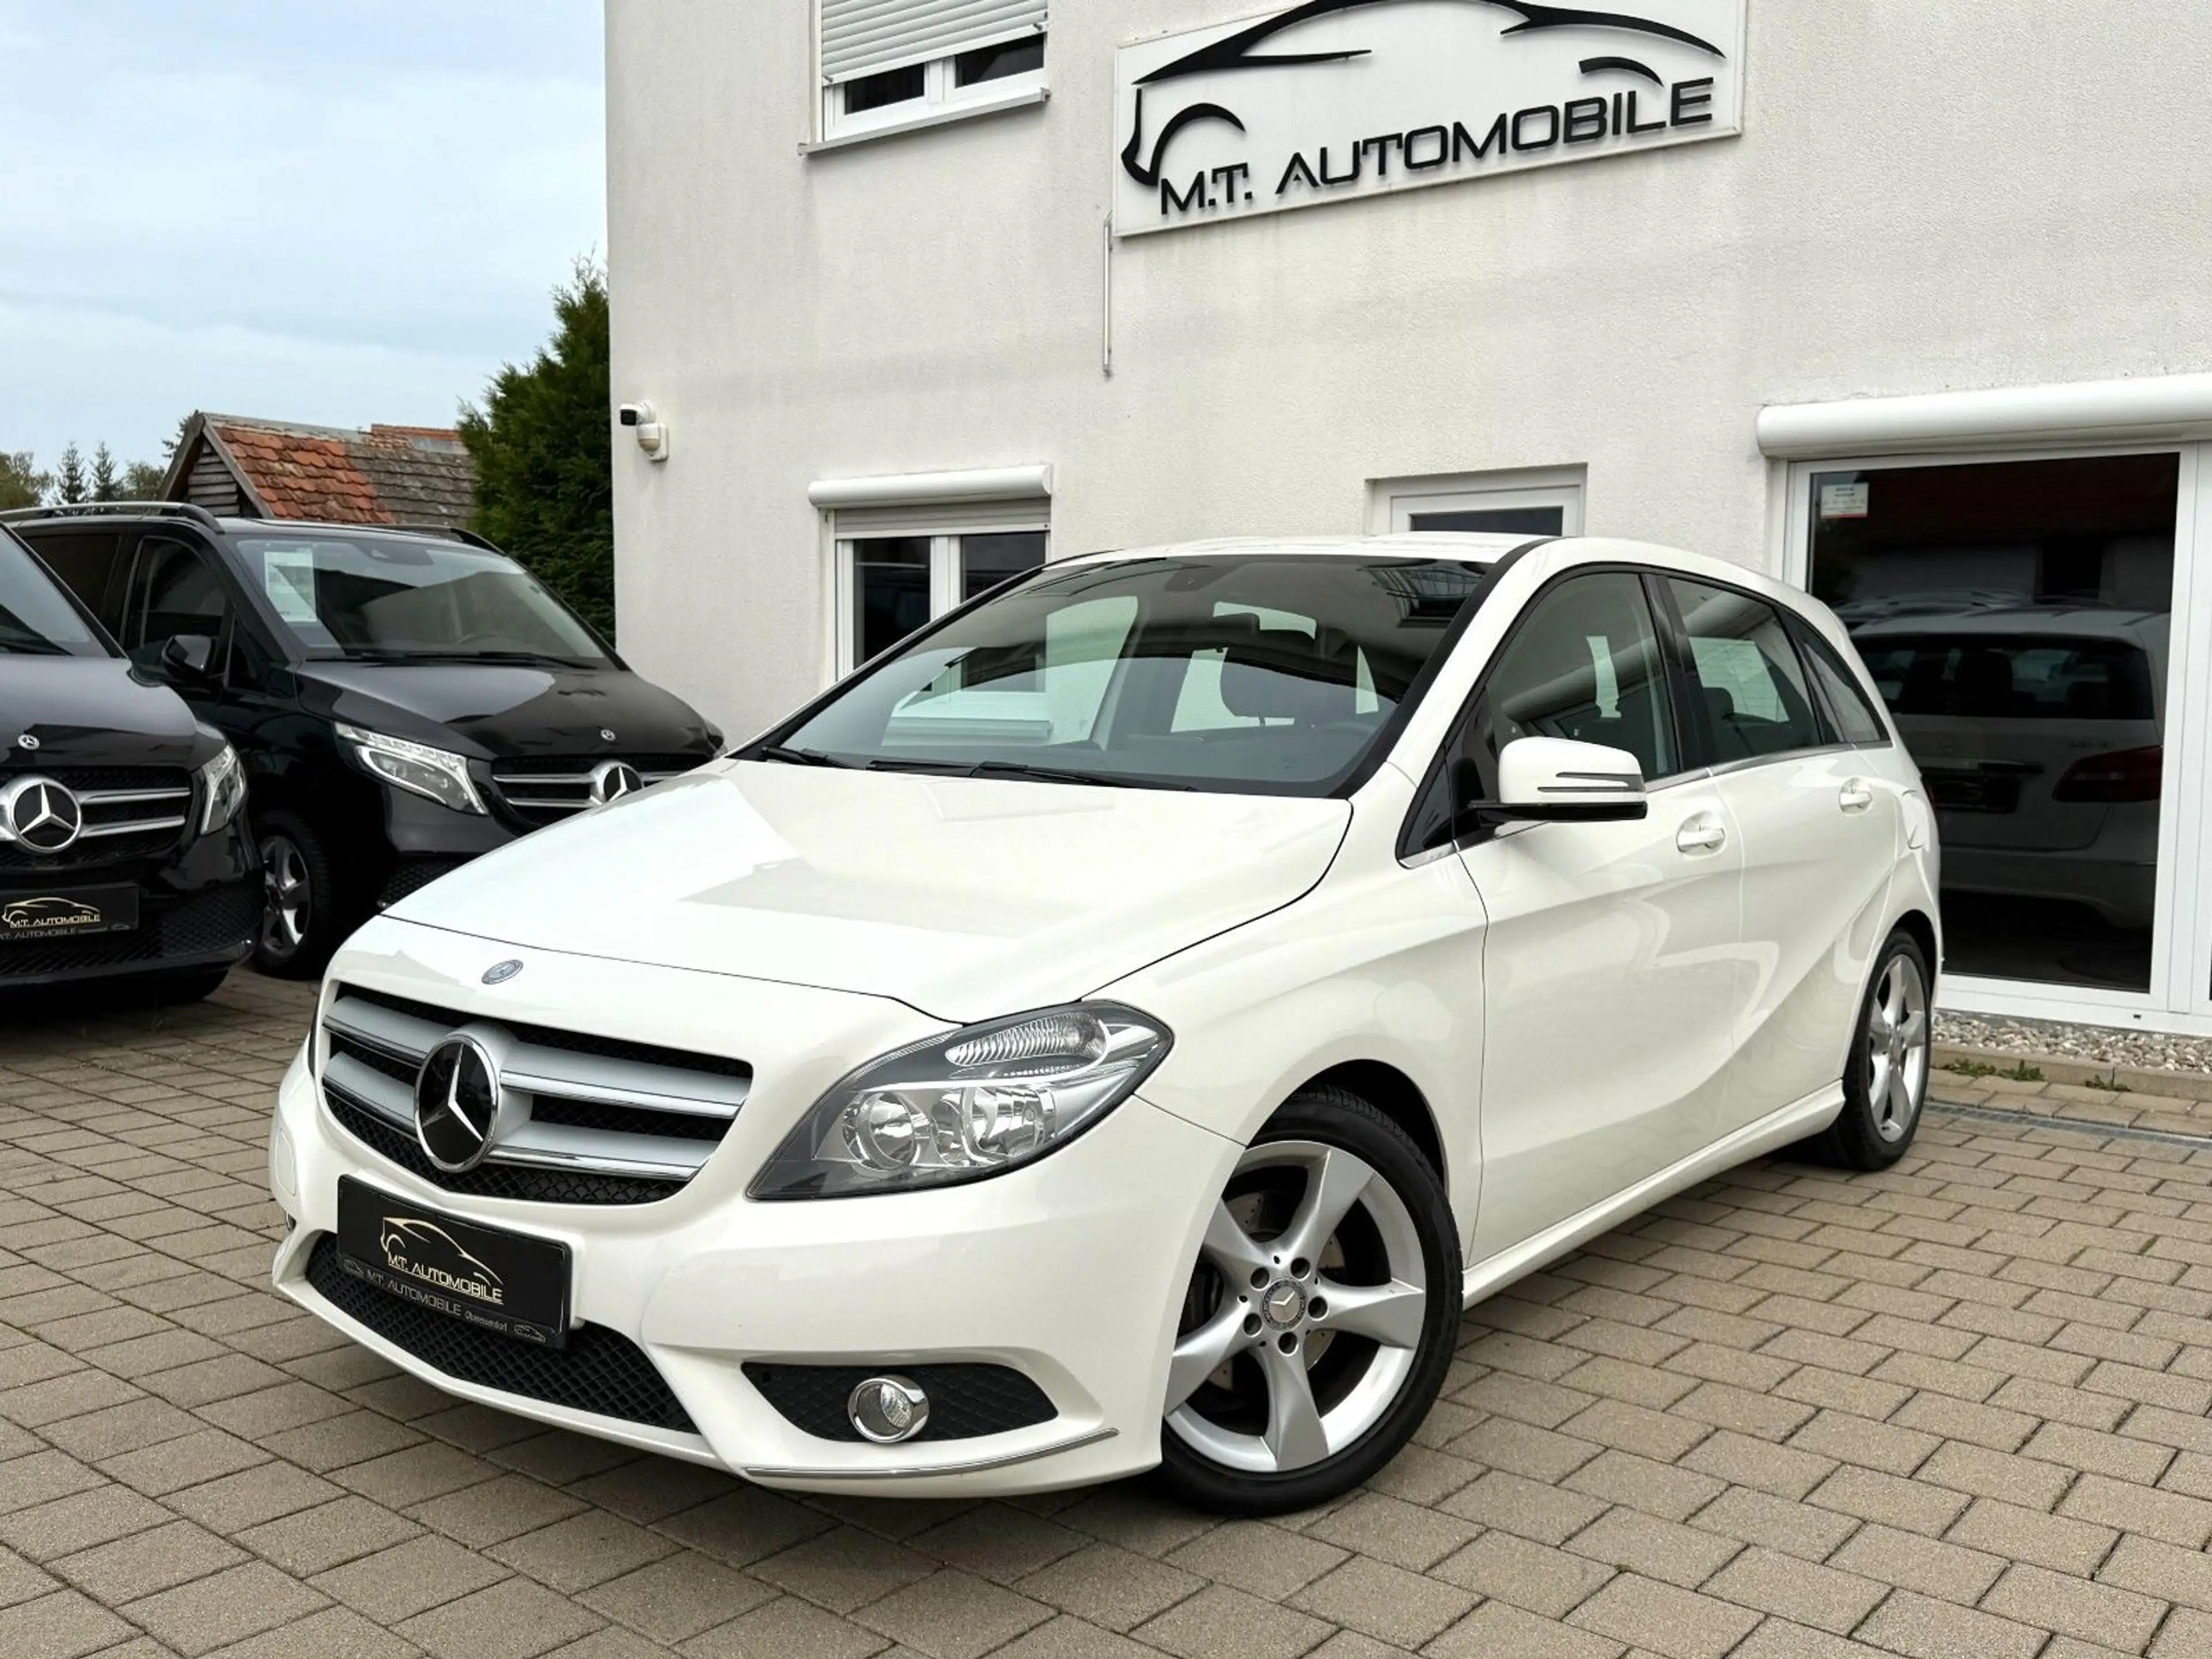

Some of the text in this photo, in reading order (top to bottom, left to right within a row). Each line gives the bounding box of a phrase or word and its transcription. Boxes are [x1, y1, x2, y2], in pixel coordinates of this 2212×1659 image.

[1161, 77, 1714, 215] M.T. AUTOMOBILE
[33, 914, 101, 926] AUTOMOBILE
[388, 1279, 461, 1316] AUTOMOBILE
[411, 1262, 503, 1301] AUTOMOBILE
